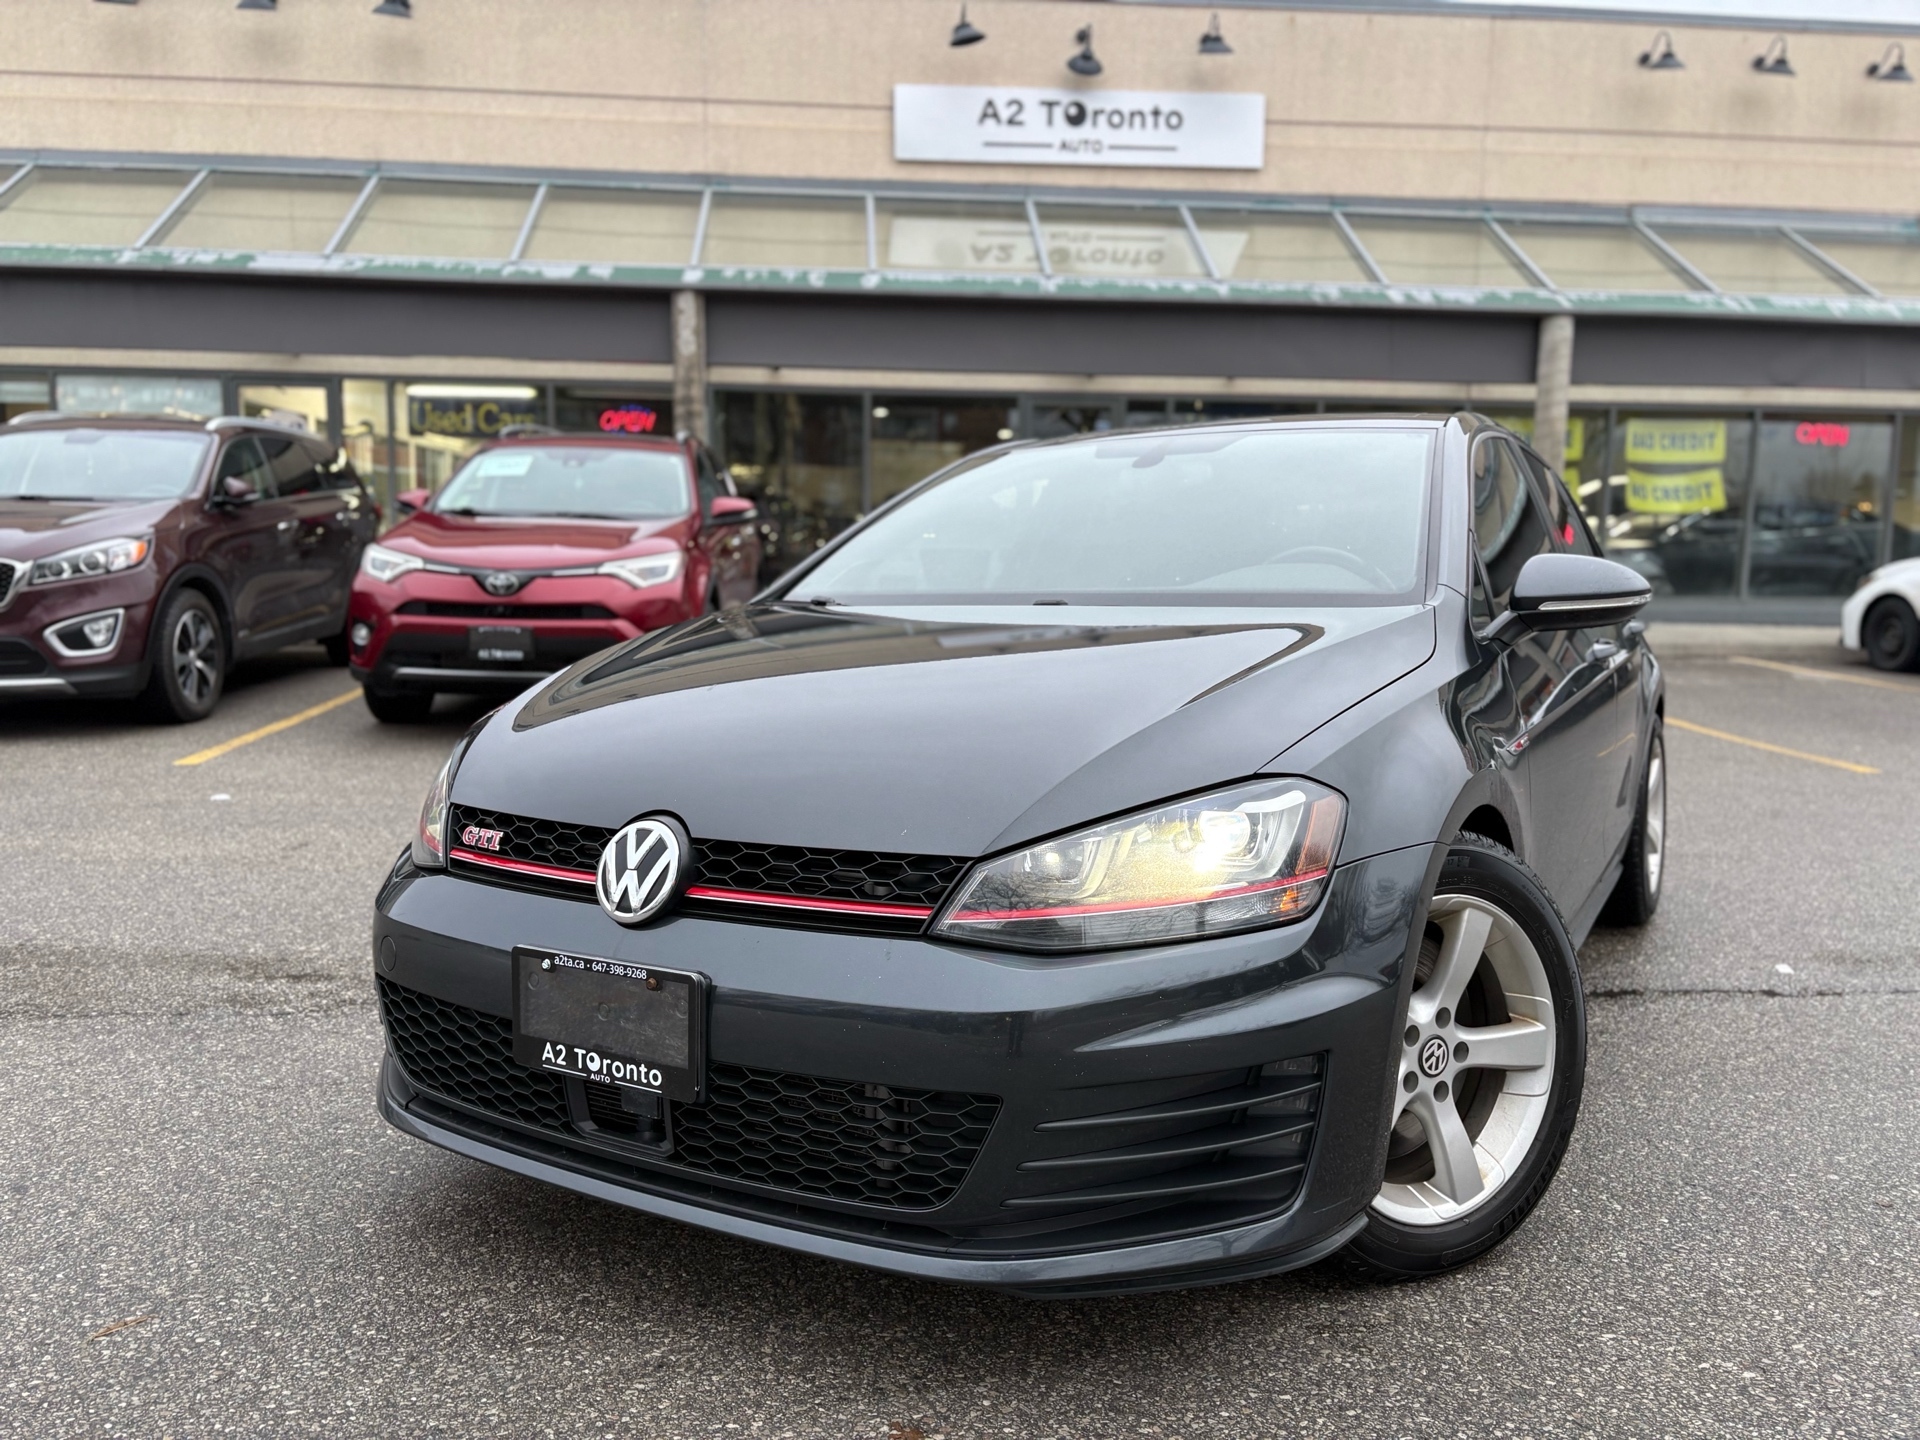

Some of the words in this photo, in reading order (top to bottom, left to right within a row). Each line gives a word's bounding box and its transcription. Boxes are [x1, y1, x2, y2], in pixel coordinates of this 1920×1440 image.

[978, 98, 1025, 126] A2
[1058, 139, 1104, 153] AUTO
[410, 400, 473, 434] Used
[598, 409, 657, 433] OPEN
[1658, 430, 1717, 451] CREDIT
[1794, 421, 1850, 447] OPEN
[1651, 481, 1714, 503] CREDIT
[462, 825, 504, 851] GTI
[554, 954, 585, 969] a2ta.ca
[591, 961, 648, 980] 647-398-9268
[541, 1041, 567, 1066] A2
[590, 1073, 611, 1084] AUTO
